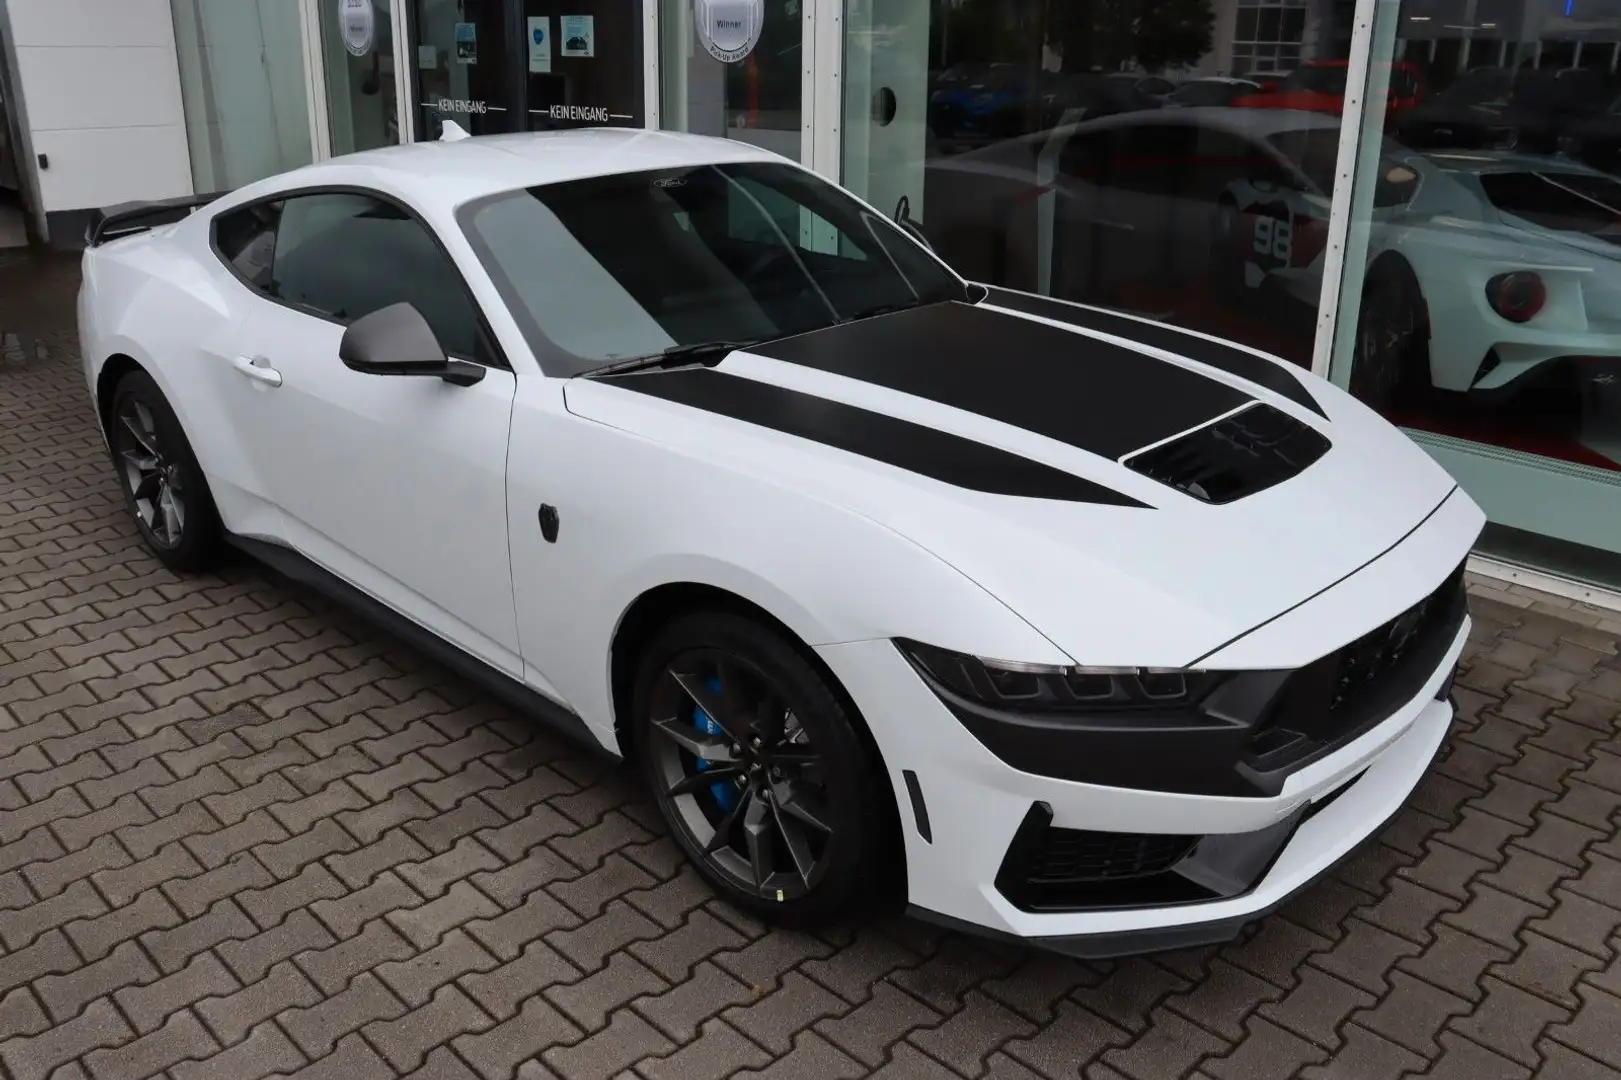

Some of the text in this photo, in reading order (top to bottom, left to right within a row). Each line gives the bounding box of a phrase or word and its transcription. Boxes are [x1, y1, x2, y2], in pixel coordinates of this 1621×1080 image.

[716, 20, 741, 28] Winner
[438, 99, 487, 114] KEIN EINGANG
[550, 104, 609, 122] KEIN EINGANG
[1253, 215, 1293, 260] 98
